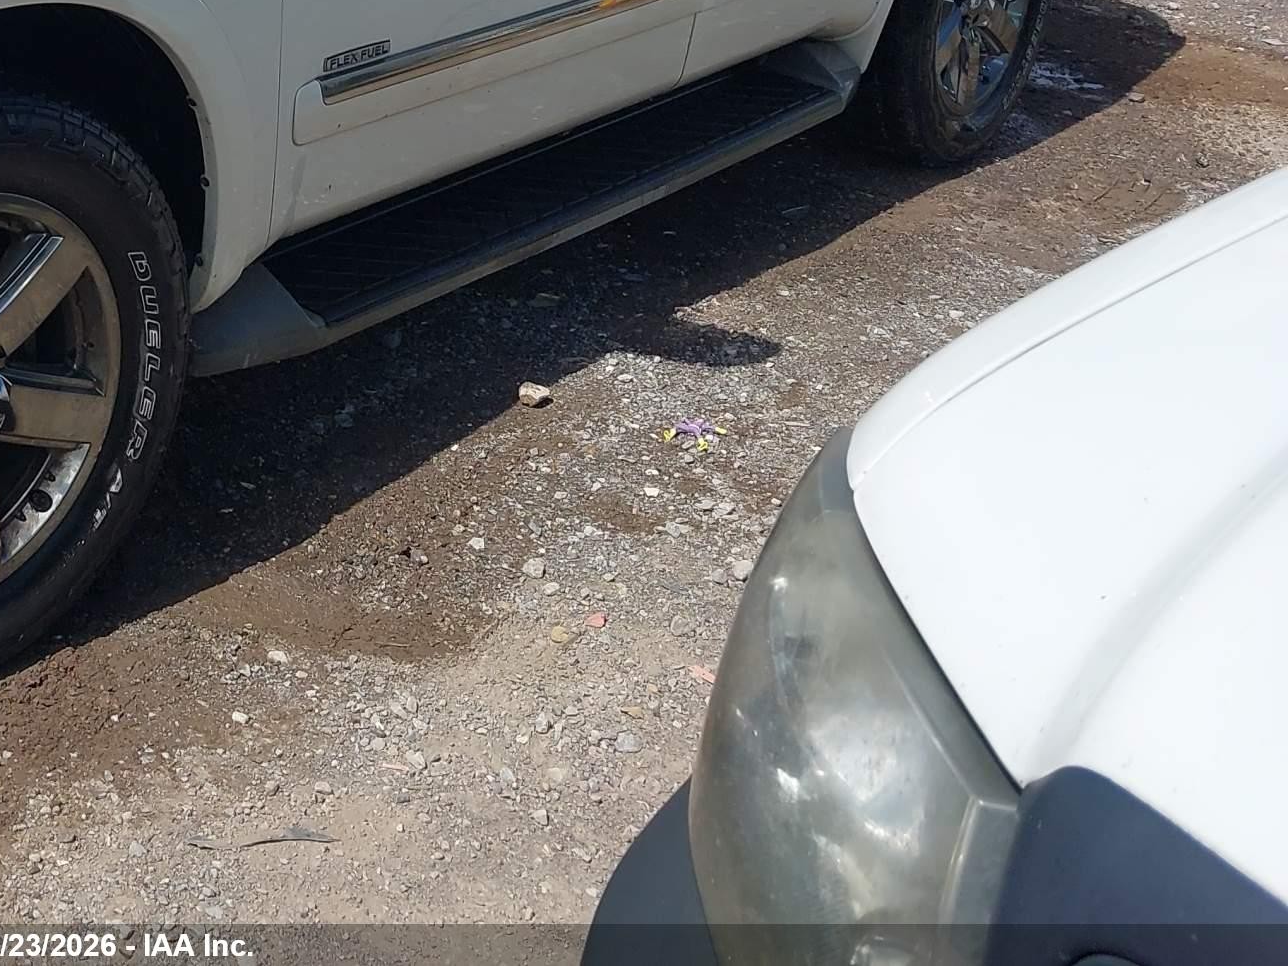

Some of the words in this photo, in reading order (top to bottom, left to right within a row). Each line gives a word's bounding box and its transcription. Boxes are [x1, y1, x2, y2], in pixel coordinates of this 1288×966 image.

[329, 54, 358, 71] FLEX
[360, 44, 390, 61] FUEL
[127, 251, 162, 461] DUELER
